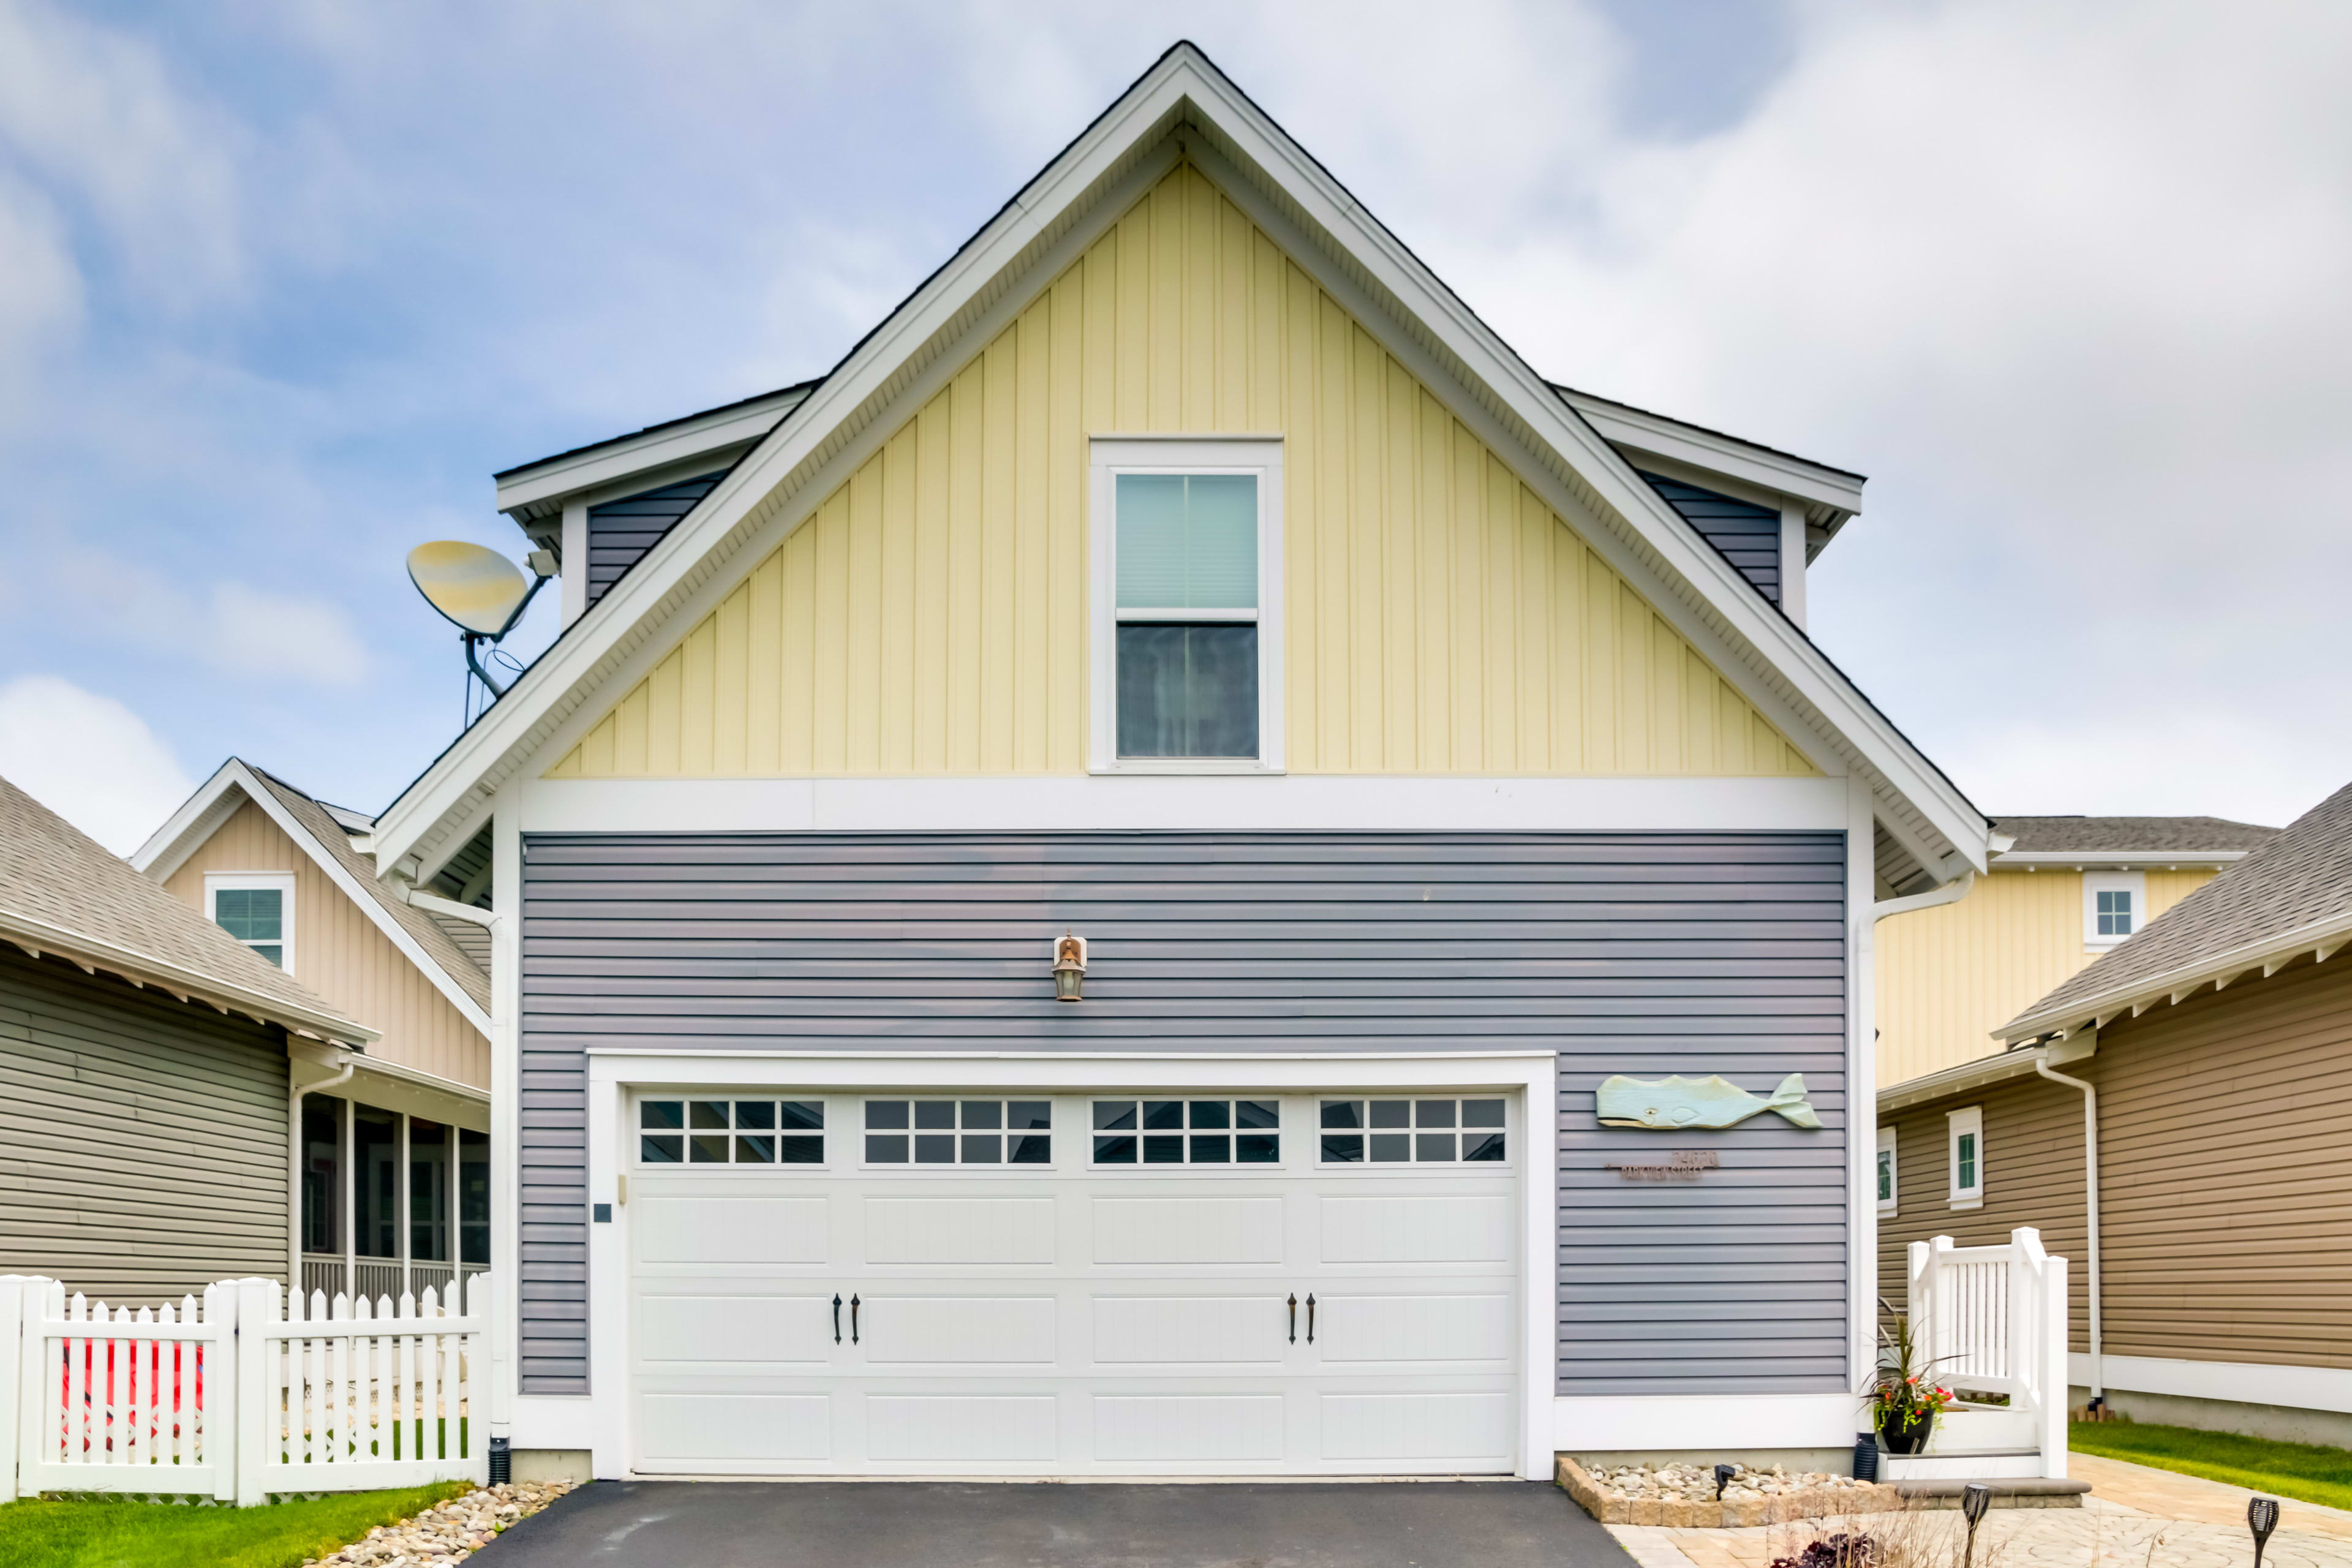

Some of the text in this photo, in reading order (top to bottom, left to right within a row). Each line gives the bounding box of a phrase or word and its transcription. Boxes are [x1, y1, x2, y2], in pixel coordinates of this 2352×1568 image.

[1621, 1166, 1703, 1180] PARK VIEW STREET
